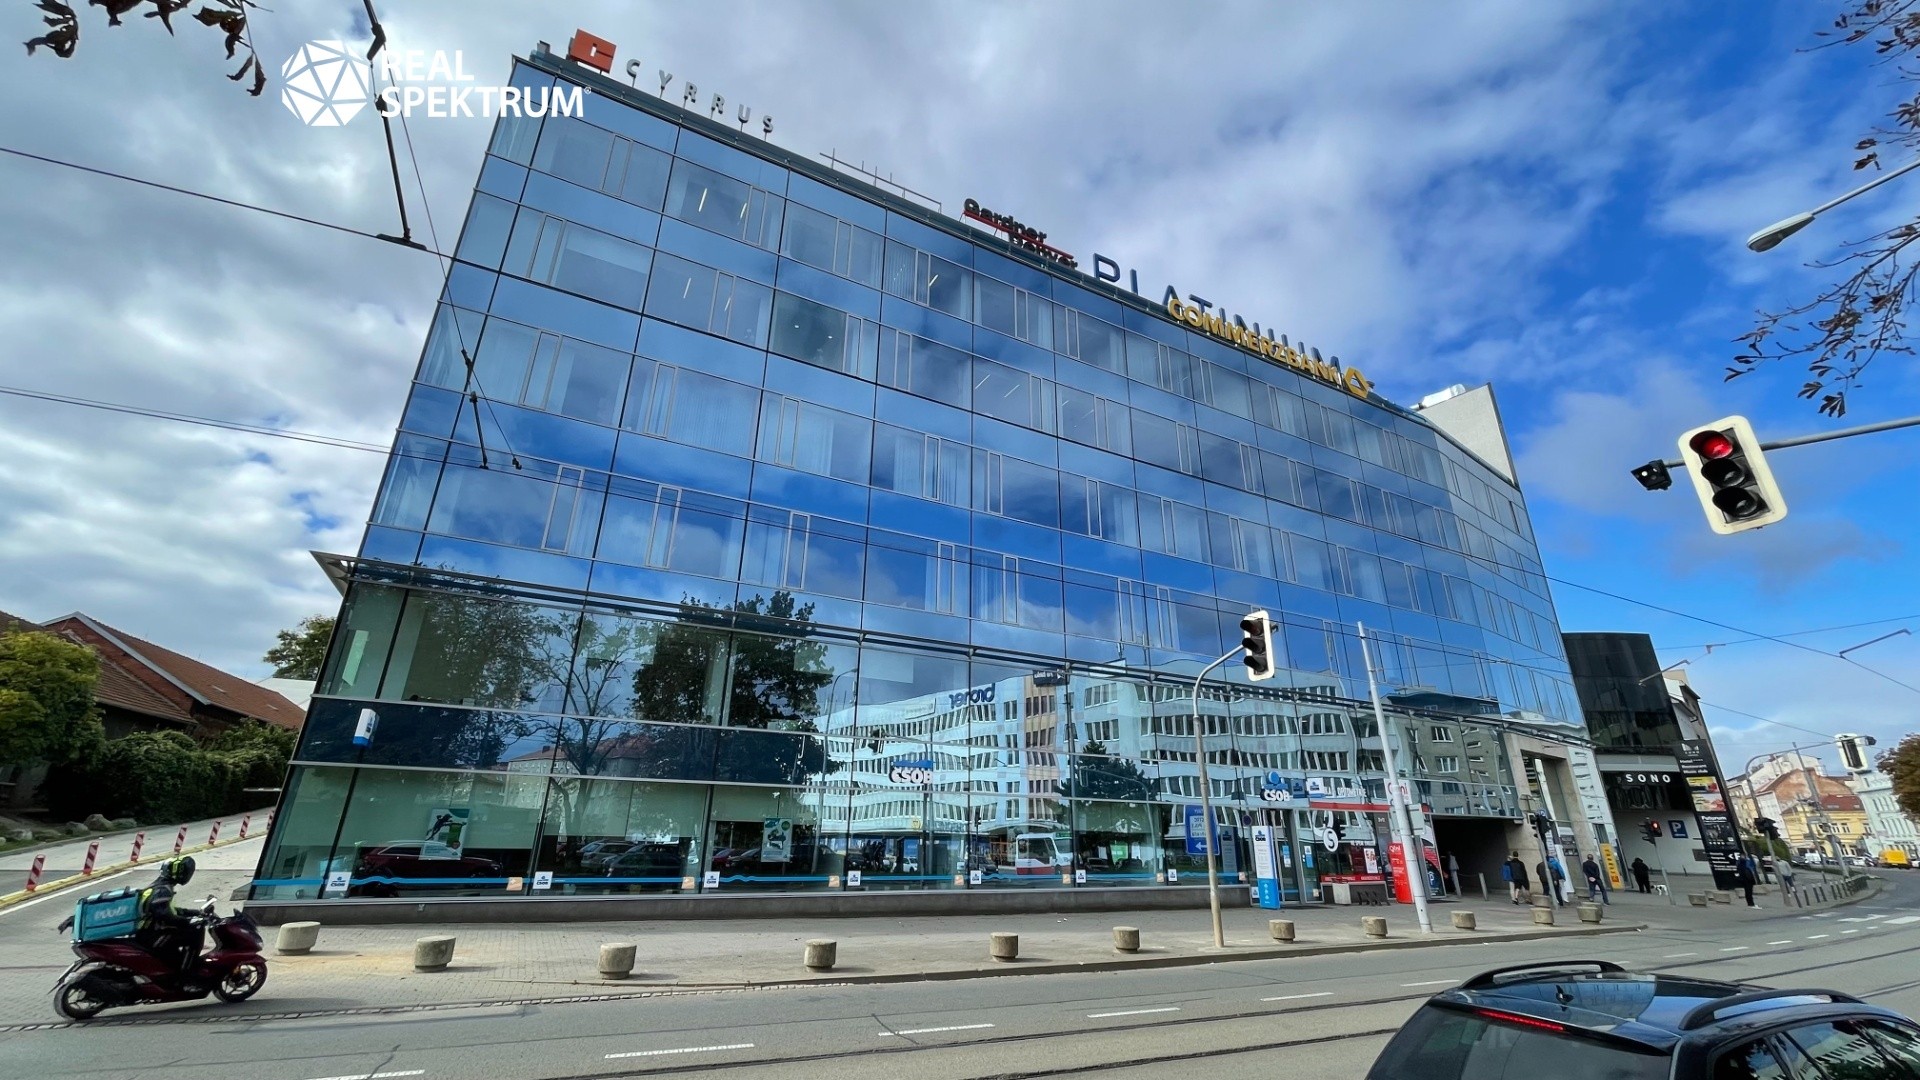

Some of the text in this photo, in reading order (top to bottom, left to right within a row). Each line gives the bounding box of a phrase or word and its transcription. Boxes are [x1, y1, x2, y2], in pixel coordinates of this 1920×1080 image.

[626, 58, 774, 134] CYRRUS
[964, 198, 1047, 243] Gardner
[1167, 299, 1343, 387] COMMERZBANK
[1625, 773, 1671, 783] SONO
